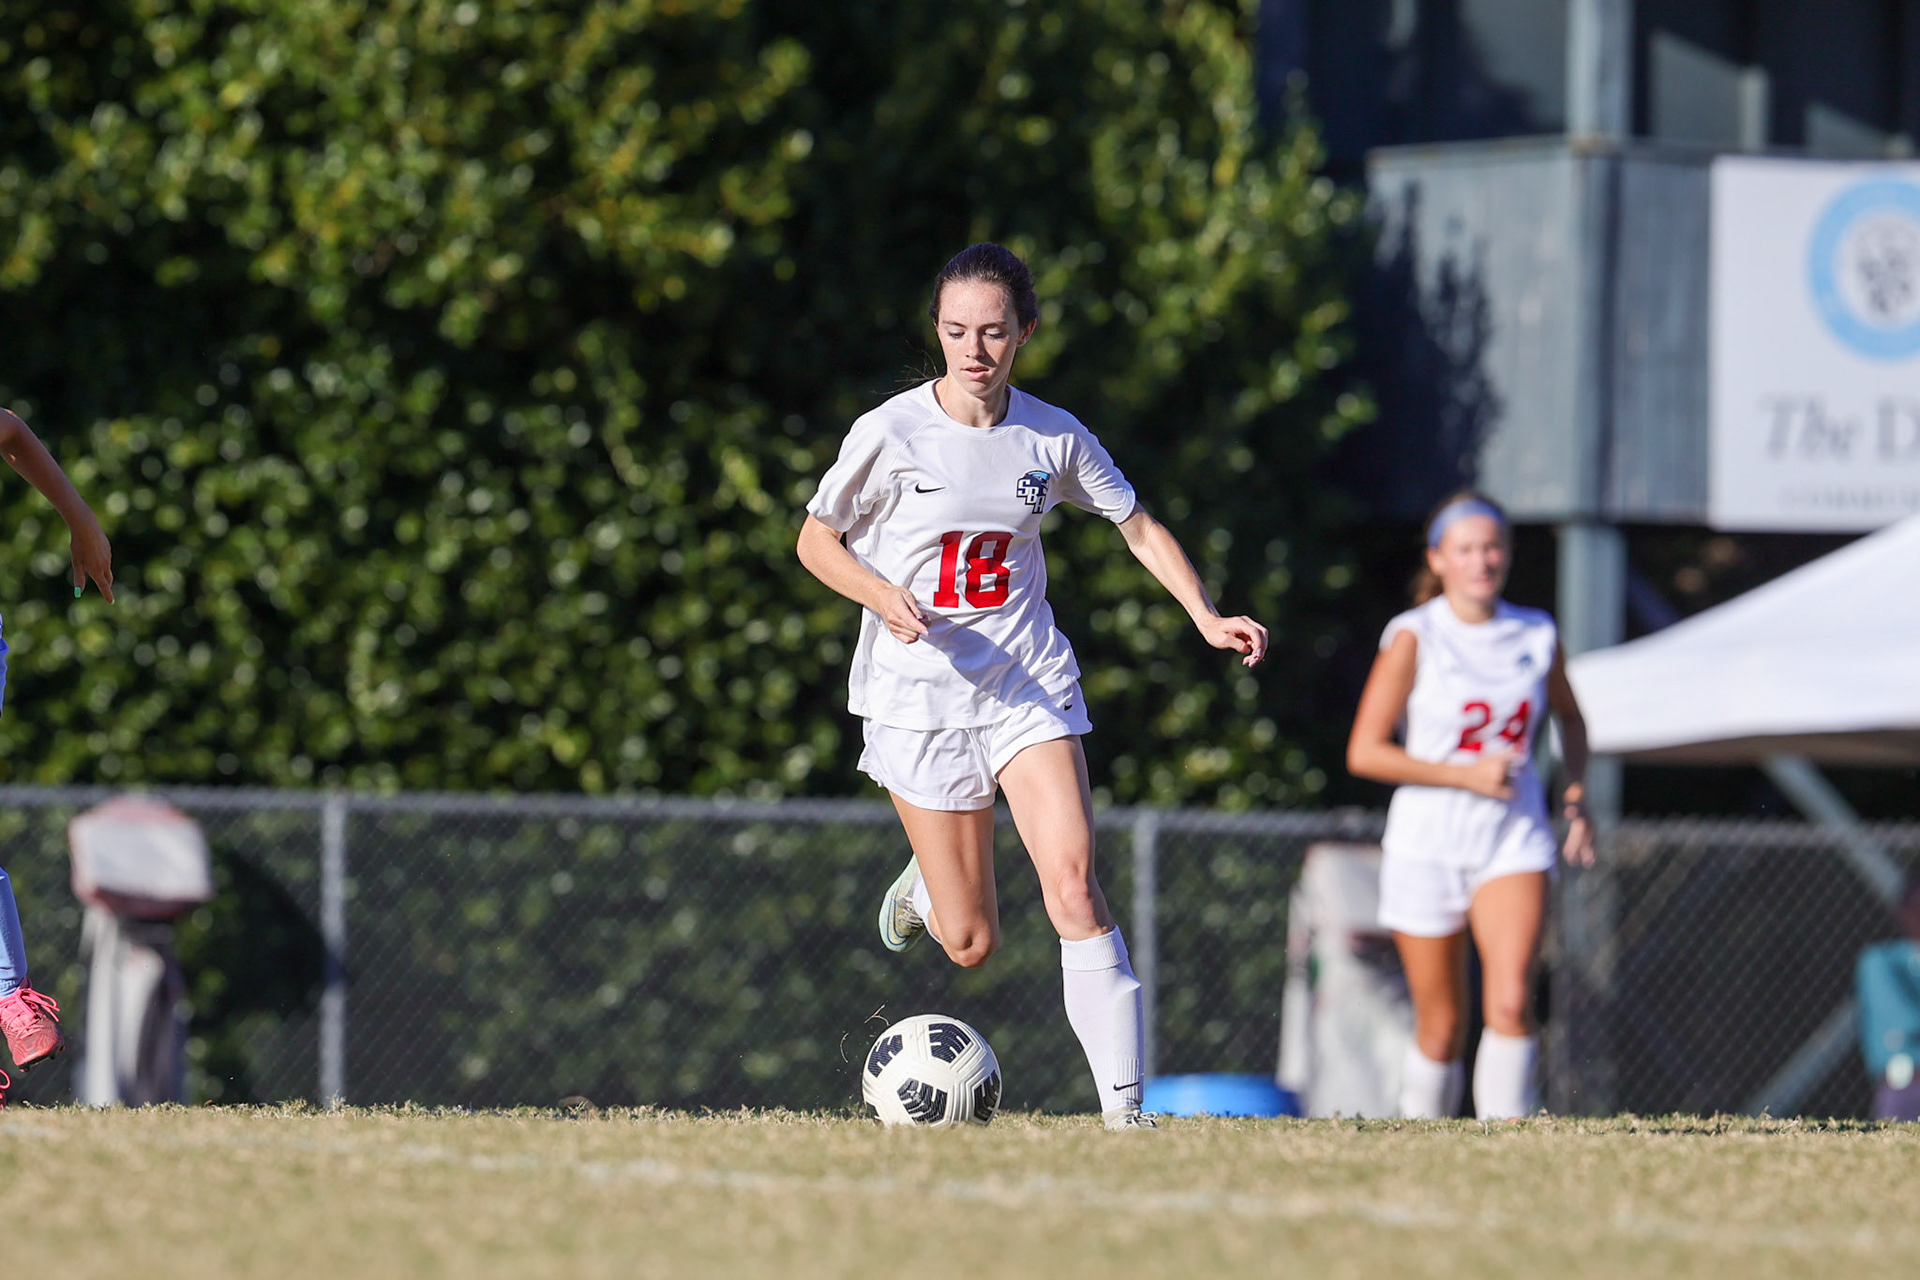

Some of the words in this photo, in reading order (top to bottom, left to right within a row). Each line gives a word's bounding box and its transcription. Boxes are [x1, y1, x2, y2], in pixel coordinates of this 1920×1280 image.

[1017, 478, 1045, 514] SBA
[933, 531, 1014, 608] 18
[1458, 699, 1530, 752] 24
